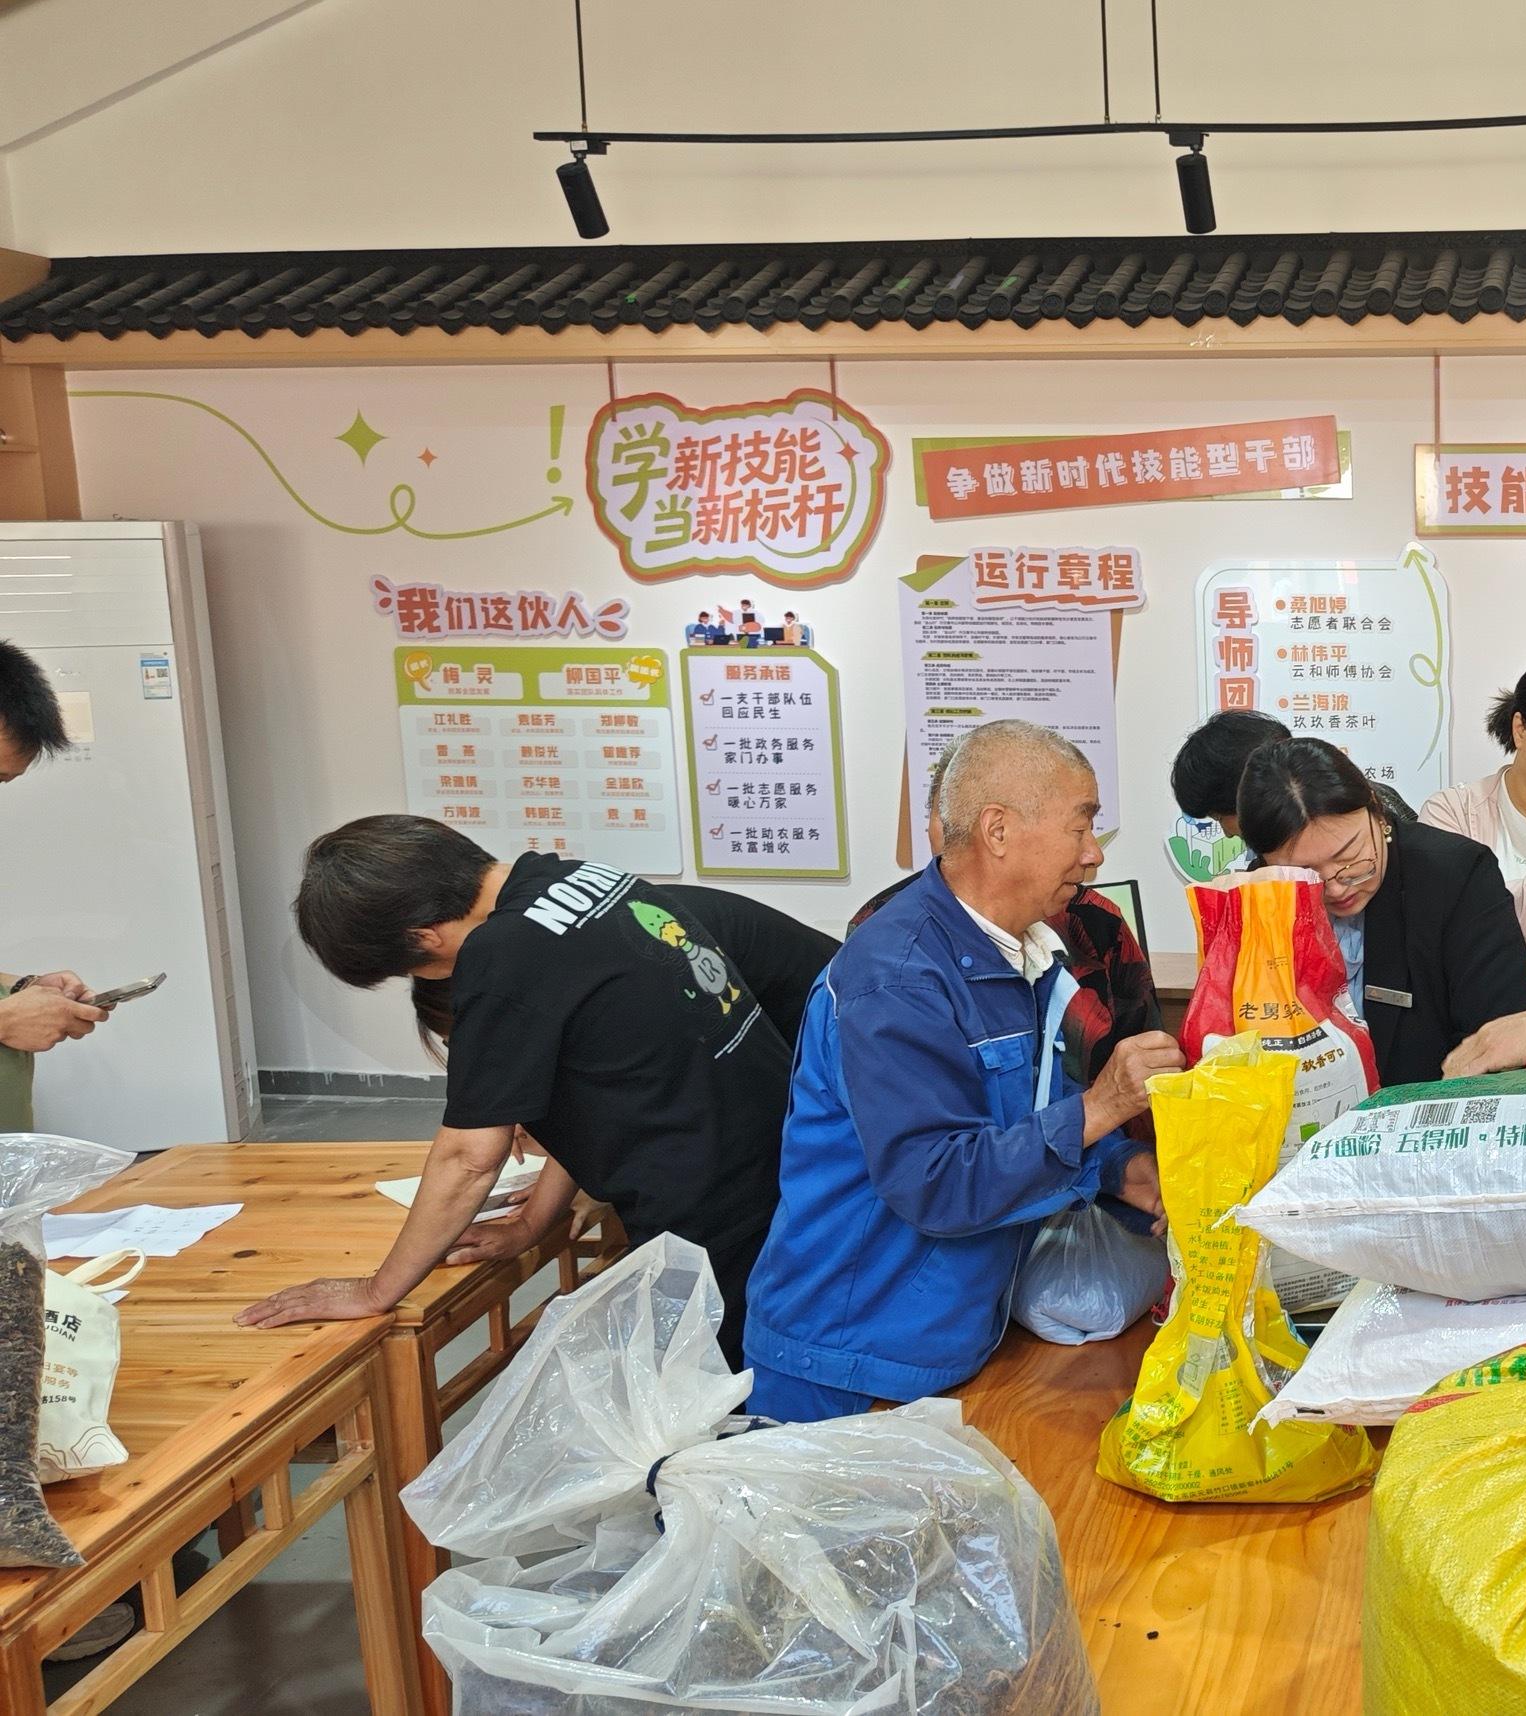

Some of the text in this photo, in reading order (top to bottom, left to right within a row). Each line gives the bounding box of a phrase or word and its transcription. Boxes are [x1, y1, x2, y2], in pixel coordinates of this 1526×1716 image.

[611, 422, 826, 521] 学新技能
[946, 435, 1316, 500] 争做新时代技能型干部
[646, 482, 844, 553] 当新标杆
[973, 552, 1137, 592] 运行章程
[400, 587, 594, 633] 我们这伙人
[1291, 615, 1393, 632] 志愿者联合会
[1216, 592, 1257, 710] 导师团
[1291, 646, 1348, 663] 林伟平
[566, 667, 621, 684] 柳国平
[726, 665, 791, 682] 服务承诺
[1292, 663, 1394, 681] 云和师傅协会
[720, 692, 814, 707] 一支干部队伍
[1292, 694, 1350, 712] 兰海波
[722, 706, 782, 720] 回应民生
[1292, 714, 1377, 730] 玖玖香茶叶
[723, 737, 816, 752] 一批政务服务
[724, 750, 784, 765] 家门办事
[727, 782, 818, 797] 一批志愿服务
[728, 796, 788, 810] 暖心万家
[730, 827, 821, 841] 一批助农服务
[731, 840, 791, 854] 致富增收
[1311, 1134, 1381, 1160] 好面粉
